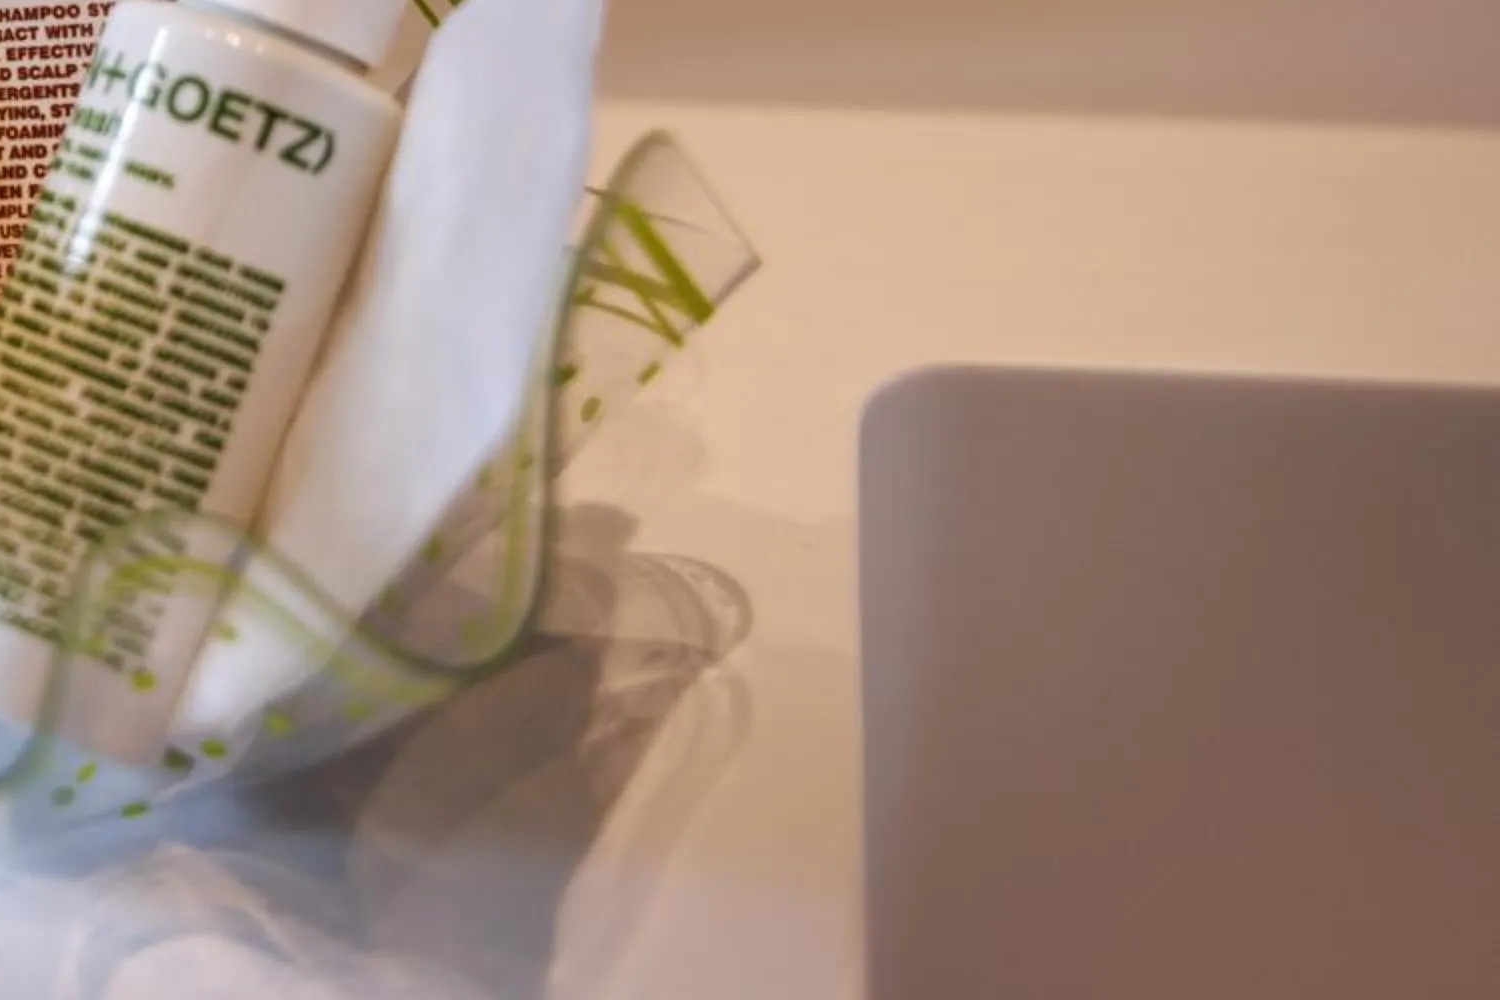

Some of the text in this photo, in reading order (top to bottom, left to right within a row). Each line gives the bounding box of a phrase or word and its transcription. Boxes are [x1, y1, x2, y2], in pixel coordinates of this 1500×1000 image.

[87, 2, 115, 17] SY
[45, 23, 93, 39] WITH
[6, 42, 96, 61] EFFECTIV
[17, 63, 78, 80] SCALP
[9, 144, 48, 160] AND
